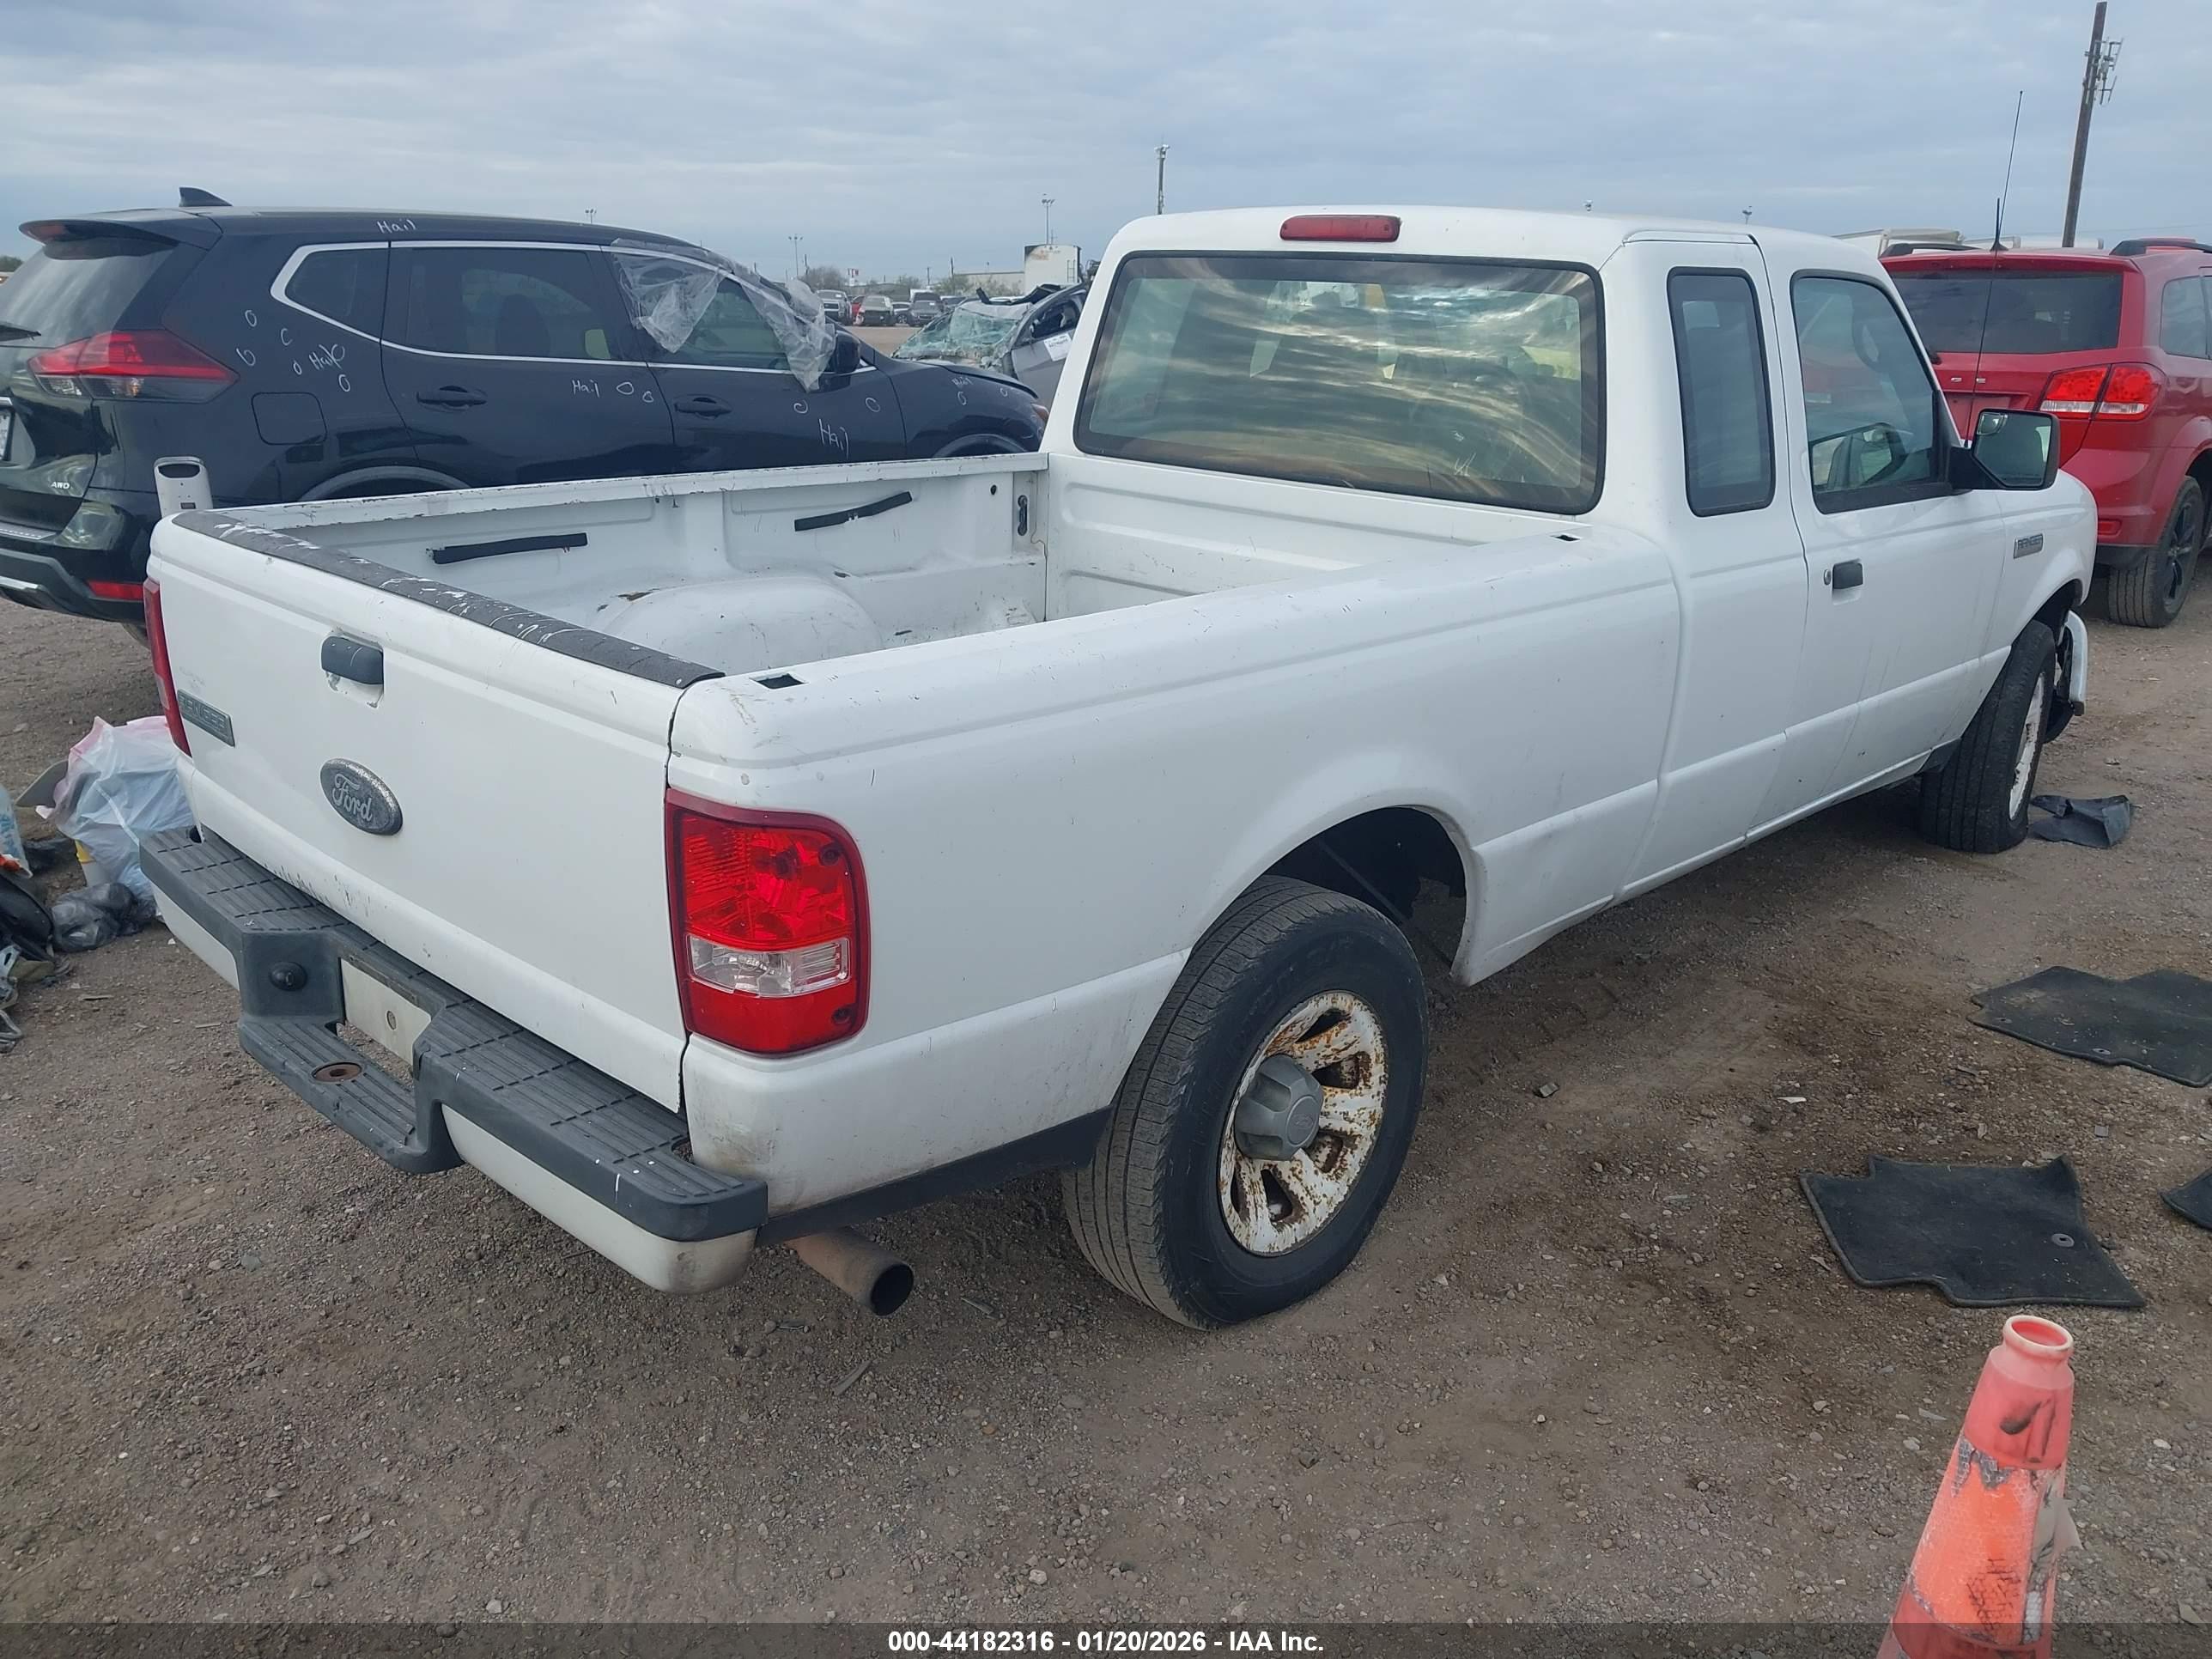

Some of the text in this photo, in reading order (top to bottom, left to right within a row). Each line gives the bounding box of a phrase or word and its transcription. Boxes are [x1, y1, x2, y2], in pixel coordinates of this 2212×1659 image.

[376, 218, 416, 234] Hail
[571, 379, 600, 398] Hail
[818, 418, 849, 460] Hail
[51, 481, 70, 489] AWD
[332, 773, 373, 822] Ford
